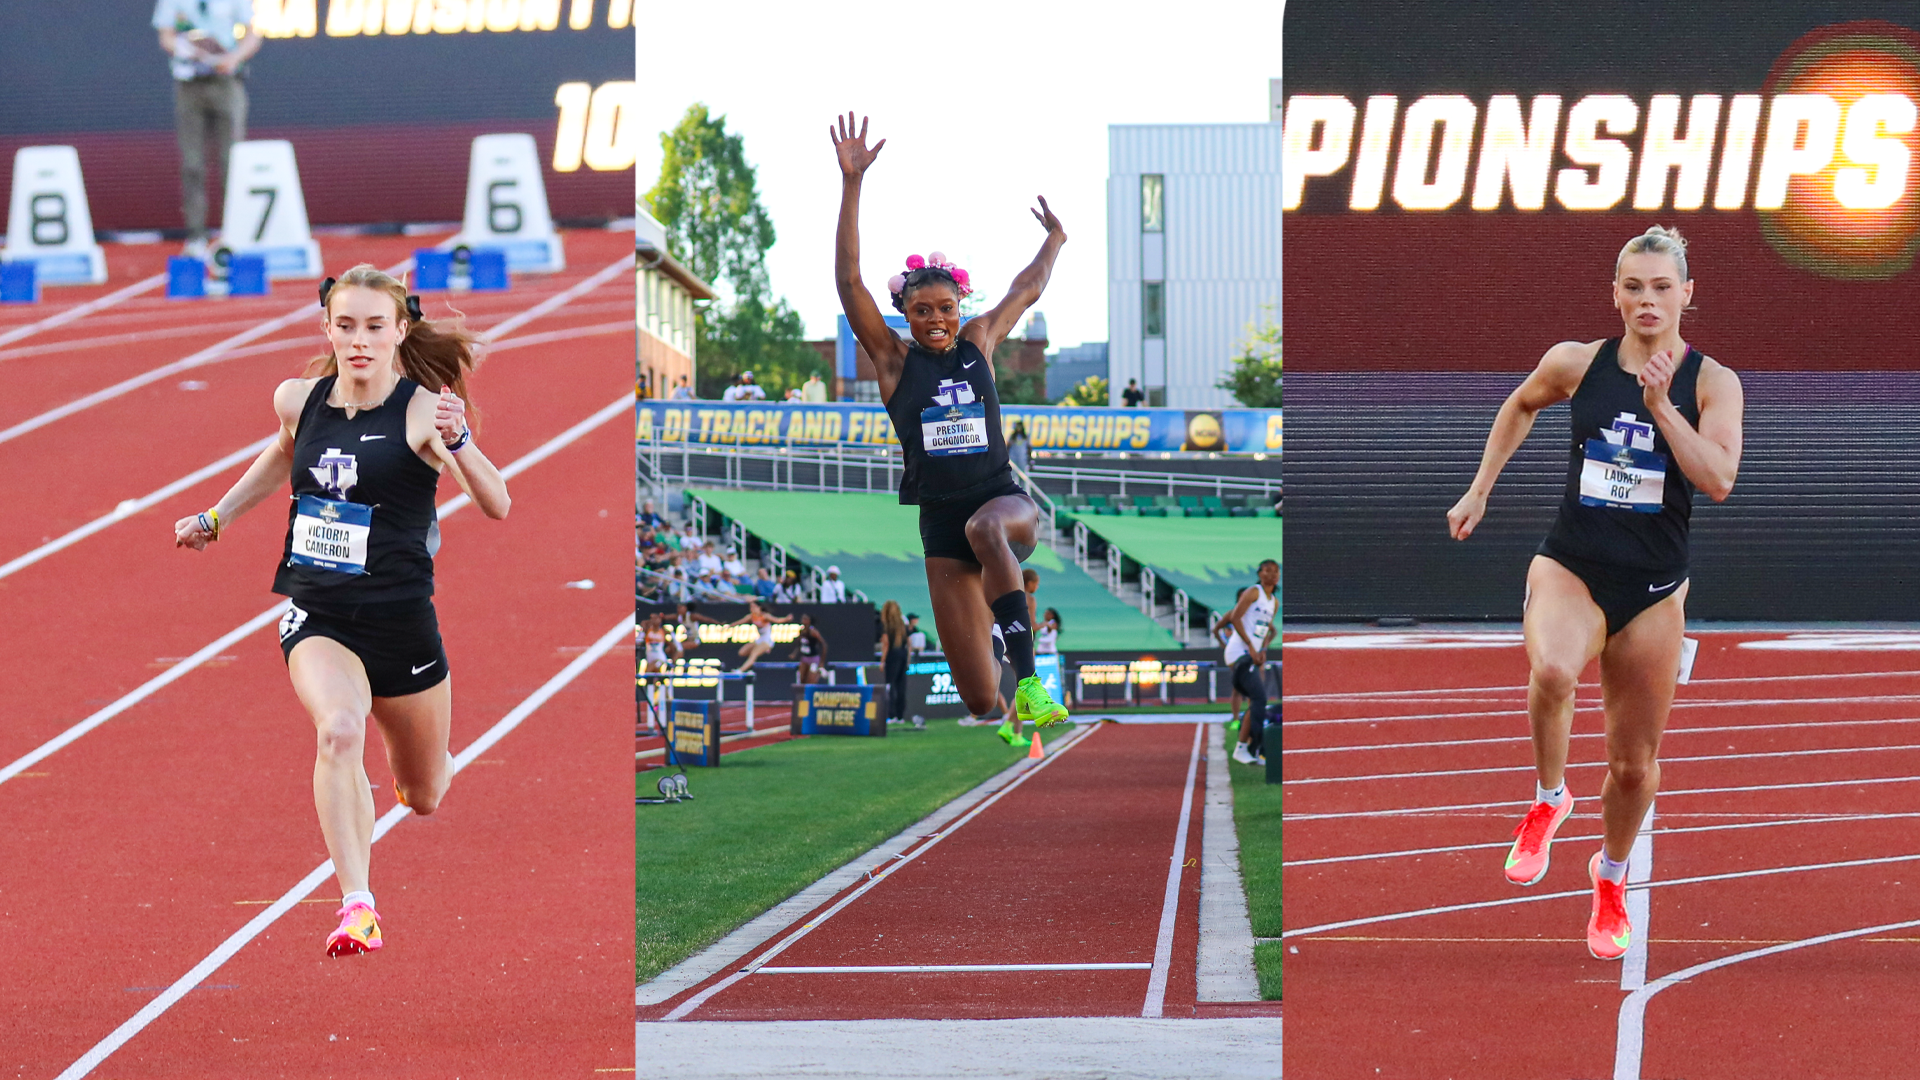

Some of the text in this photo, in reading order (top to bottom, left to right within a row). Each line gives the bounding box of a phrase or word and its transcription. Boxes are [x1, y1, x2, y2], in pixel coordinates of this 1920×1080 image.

[553, 81, 636, 172] 10
[1282, 94, 1918, 210] PIONSHIPS
[31, 192, 68, 245] 8
[249, 186, 279, 242] 7
[488, 181, 521, 233] 6
[662, 409, 692, 442] DI
[698, 409, 783, 444] TRACK
[785, 410, 842, 445] AND
[847, 411, 901, 445] FIEL
[1001, 414, 1151, 449] PIONSHIPS
[932, 434, 981, 447] OCHONOGOR
[936, 423, 975, 436] PRESTINA
[1604, 468, 1642, 485] LAUREN
[1611, 485, 1631, 499] ROY
[308, 524, 350, 543] VICTORIA
[305, 539, 350, 559] CAMERON
